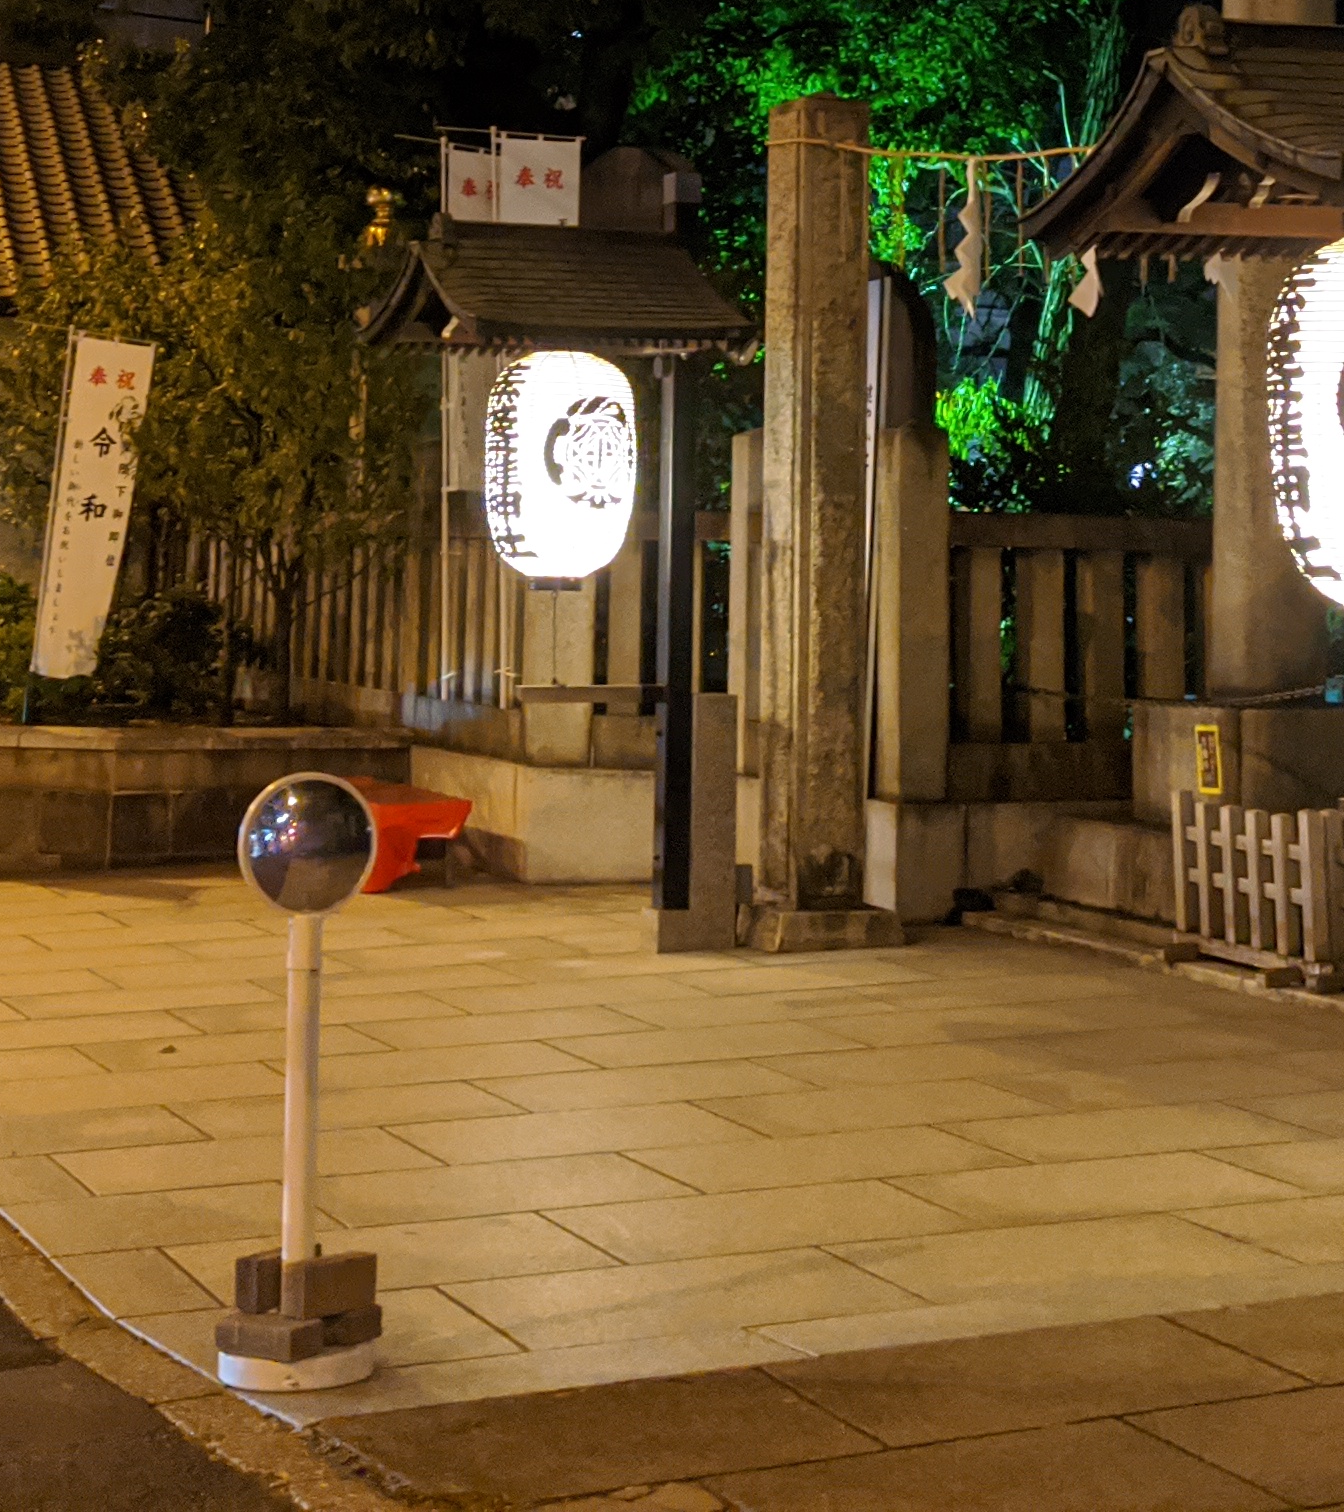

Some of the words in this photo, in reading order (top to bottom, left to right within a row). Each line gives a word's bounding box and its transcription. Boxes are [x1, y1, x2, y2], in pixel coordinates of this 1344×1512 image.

[515, 166, 564, 190] 奉祝
[89, 365, 136, 390] 奉祝
[77, 425, 117, 522] 令和
